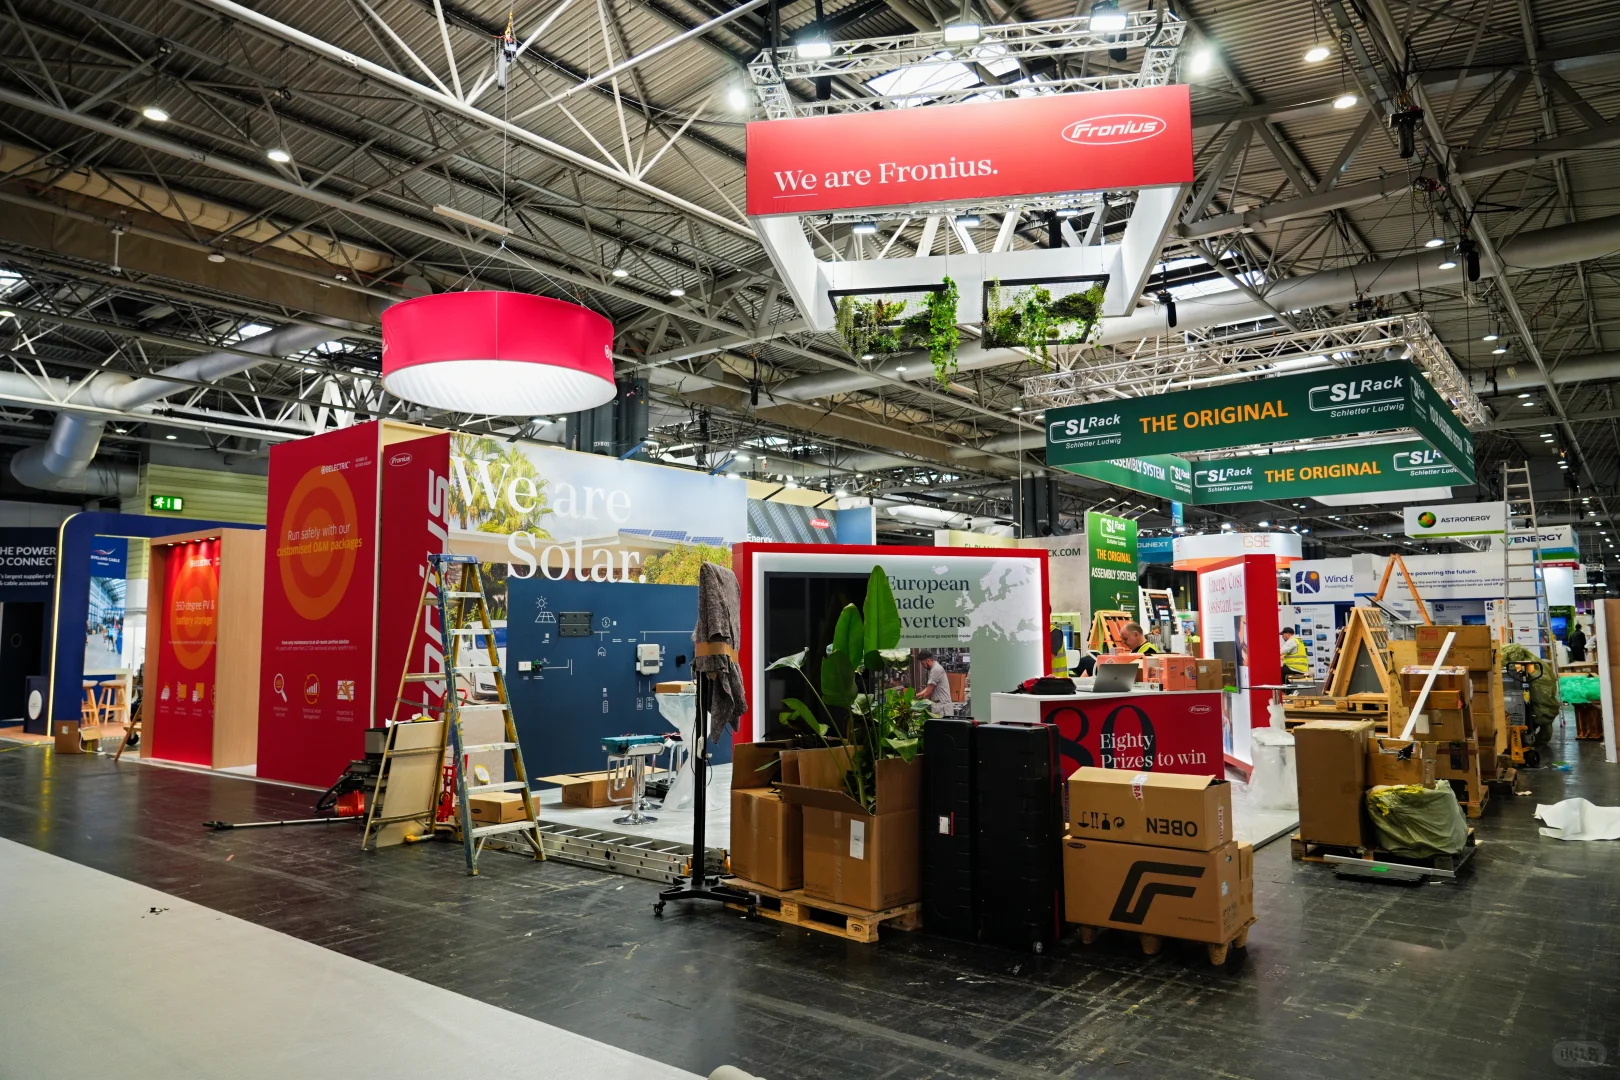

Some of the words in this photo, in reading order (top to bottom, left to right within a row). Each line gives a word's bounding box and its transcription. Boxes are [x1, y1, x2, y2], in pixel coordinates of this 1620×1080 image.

[1071, 120, 1157, 139] Fronius
[773, 169, 818, 192] We
[824, 165, 871, 188] are
[879, 157, 999, 184] Fronius.
[1139, 413, 1178, 434] THE
[1183, 400, 1288, 429] ORIGINAL
[1330, 406, 1370, 418] Schletter
[1372, 402, 1404, 415] Ludwig
[1065, 440, 1095, 449] Schletter
[1097, 437, 1121, 445] Ludwig
[1142, 462, 1166, 481] SYSTEM
[1264, 468, 1295, 482] THE
[1299, 461, 1381, 481] ORIGINAL
[1410, 469, 1440, 477] Schletter
[450, 455, 538, 513] We
[552, 480, 632, 524] are
[1440, 515, 1490, 523] ASTRONERGY
[288, 530, 300, 541] Run
[301, 526, 320, 540] safely
[322, 525, 337, 536] with
[338, 524, 351, 535] our
[276, 543, 312, 557] customised
[313, 541, 329, 552] O&M
[330, 537, 363, 553] packages
[1243, 535, 1270, 548] GSE
[16, 546, 56, 555] POWER
[507, 530, 647, 584] Solar.
[1096, 548, 1107, 560] THE
[1108, 550, 1131, 564] ORIGINAL
[1091, 567, 1116, 579] ASSEMBLY
[1116, 570, 1137, 581] SYSTEMS
[1325, 575, 1348, 583] Wind
[887, 576, 970, 593] European
[1208, 577, 1227, 595] Energy
[1228, 572, 1242, 590] Cost
[175, 601, 202, 611] 360-degree
[203, 600, 210, 610] PV
[175, 615, 194, 627] battery
[194, 616, 213, 627] storage
[1100, 732, 1154, 751] Eighty
[1101, 753, 1153, 769] Prizes
[1157, 752, 1174, 766] to
[1178, 749, 1207, 765] win
[1146, 817, 1198, 837] OBEN
